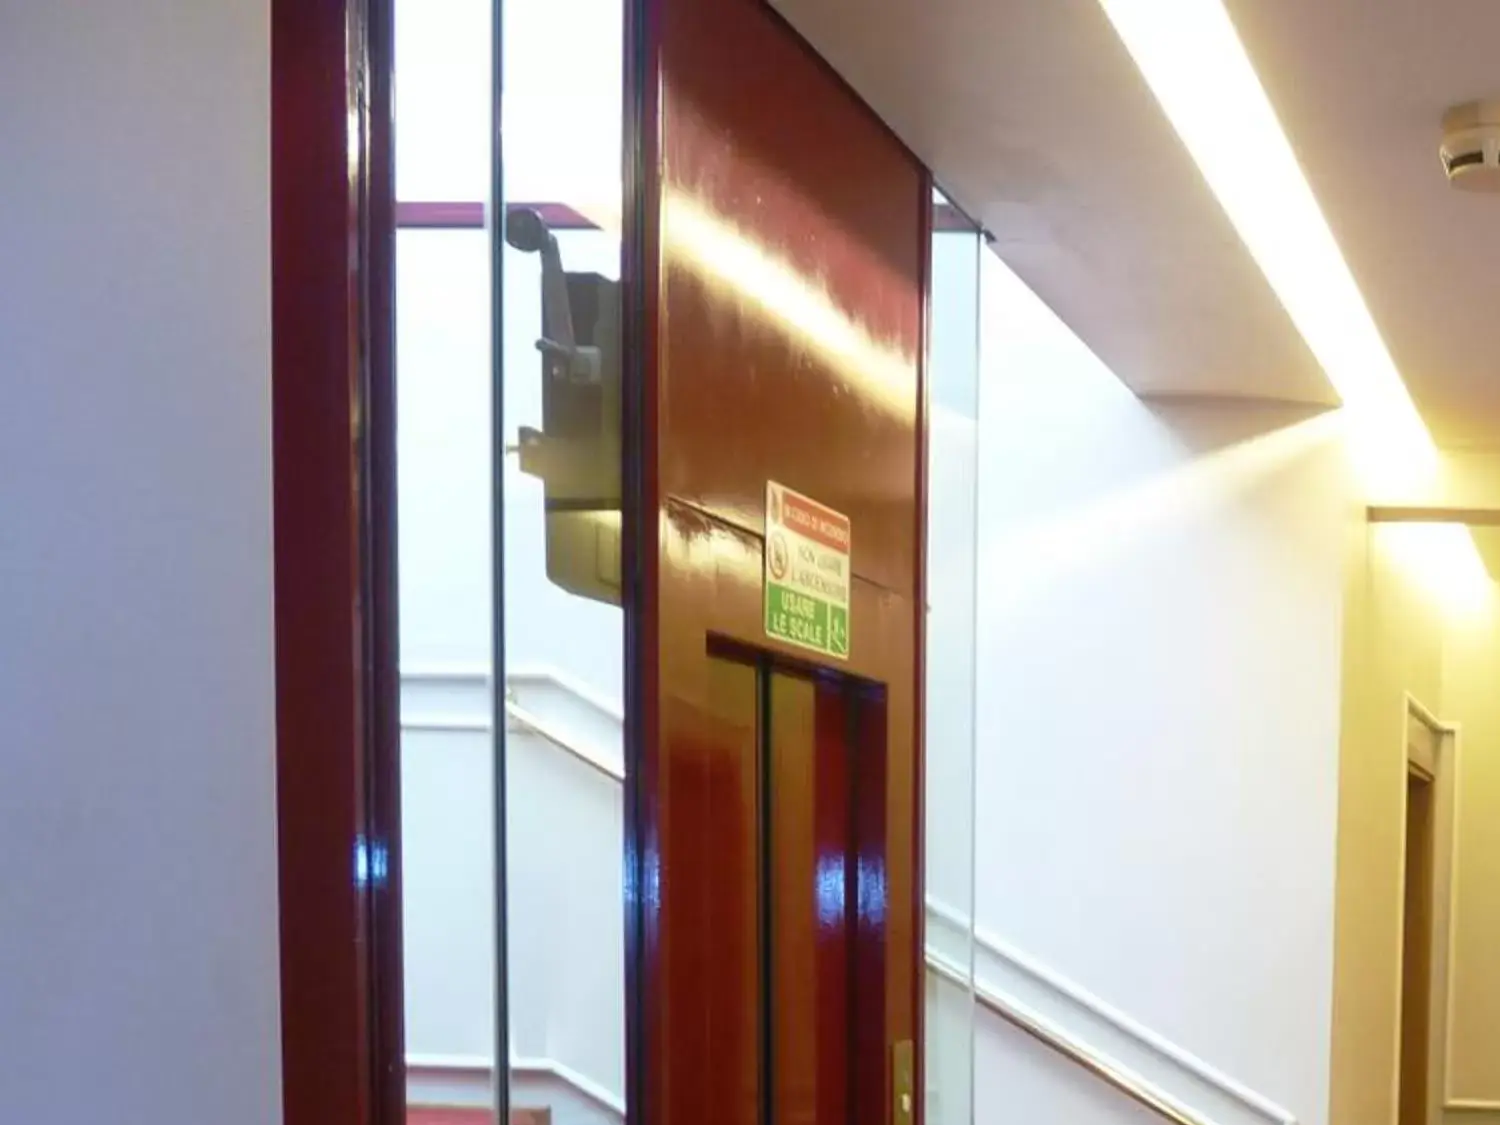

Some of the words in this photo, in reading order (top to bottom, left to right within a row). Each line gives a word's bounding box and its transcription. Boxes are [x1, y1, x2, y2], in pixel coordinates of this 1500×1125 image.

[781, 590, 815, 620] USARE
[773, 611, 787, 634] LE
[789, 616, 822, 645] SCALE
